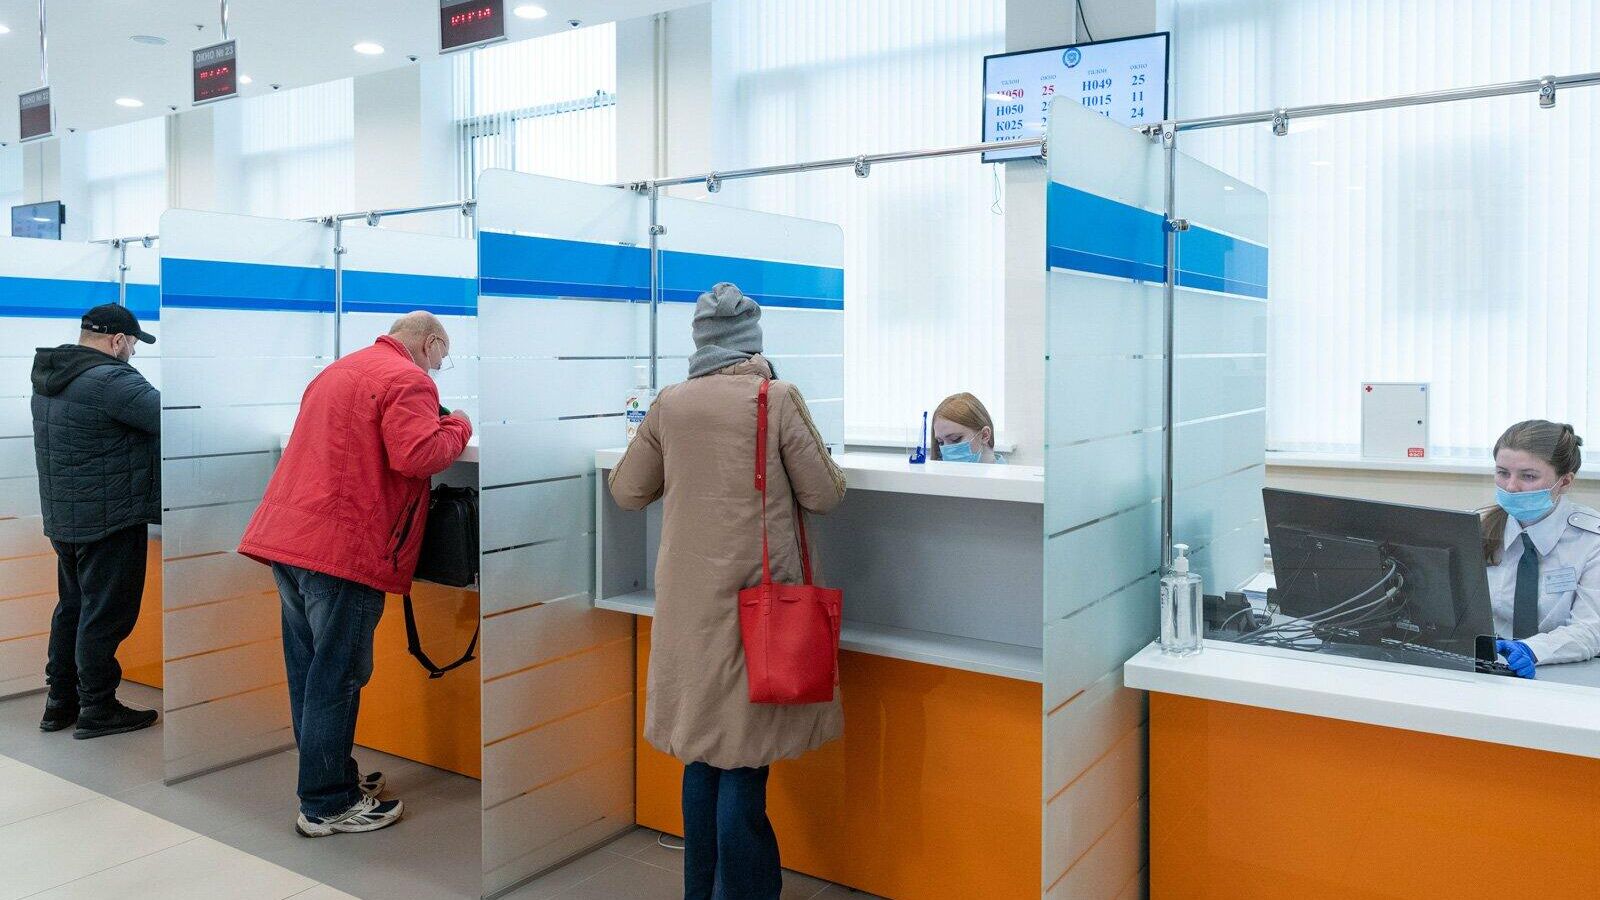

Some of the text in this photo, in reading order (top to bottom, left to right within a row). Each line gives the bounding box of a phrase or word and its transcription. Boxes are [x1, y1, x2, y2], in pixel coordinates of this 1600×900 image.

[196, 50, 214, 63] ОКНО
[224, 45, 234, 56] 23
[1082, 74, 1145, 91] Н049 25
[1042, 85, 1055, 96] 25
[1082, 91, 1143, 106] П015 11
[996, 104, 1024, 116] Н050
[1131, 107, 1145, 118] 24
[996, 119, 1023, 131] К025
